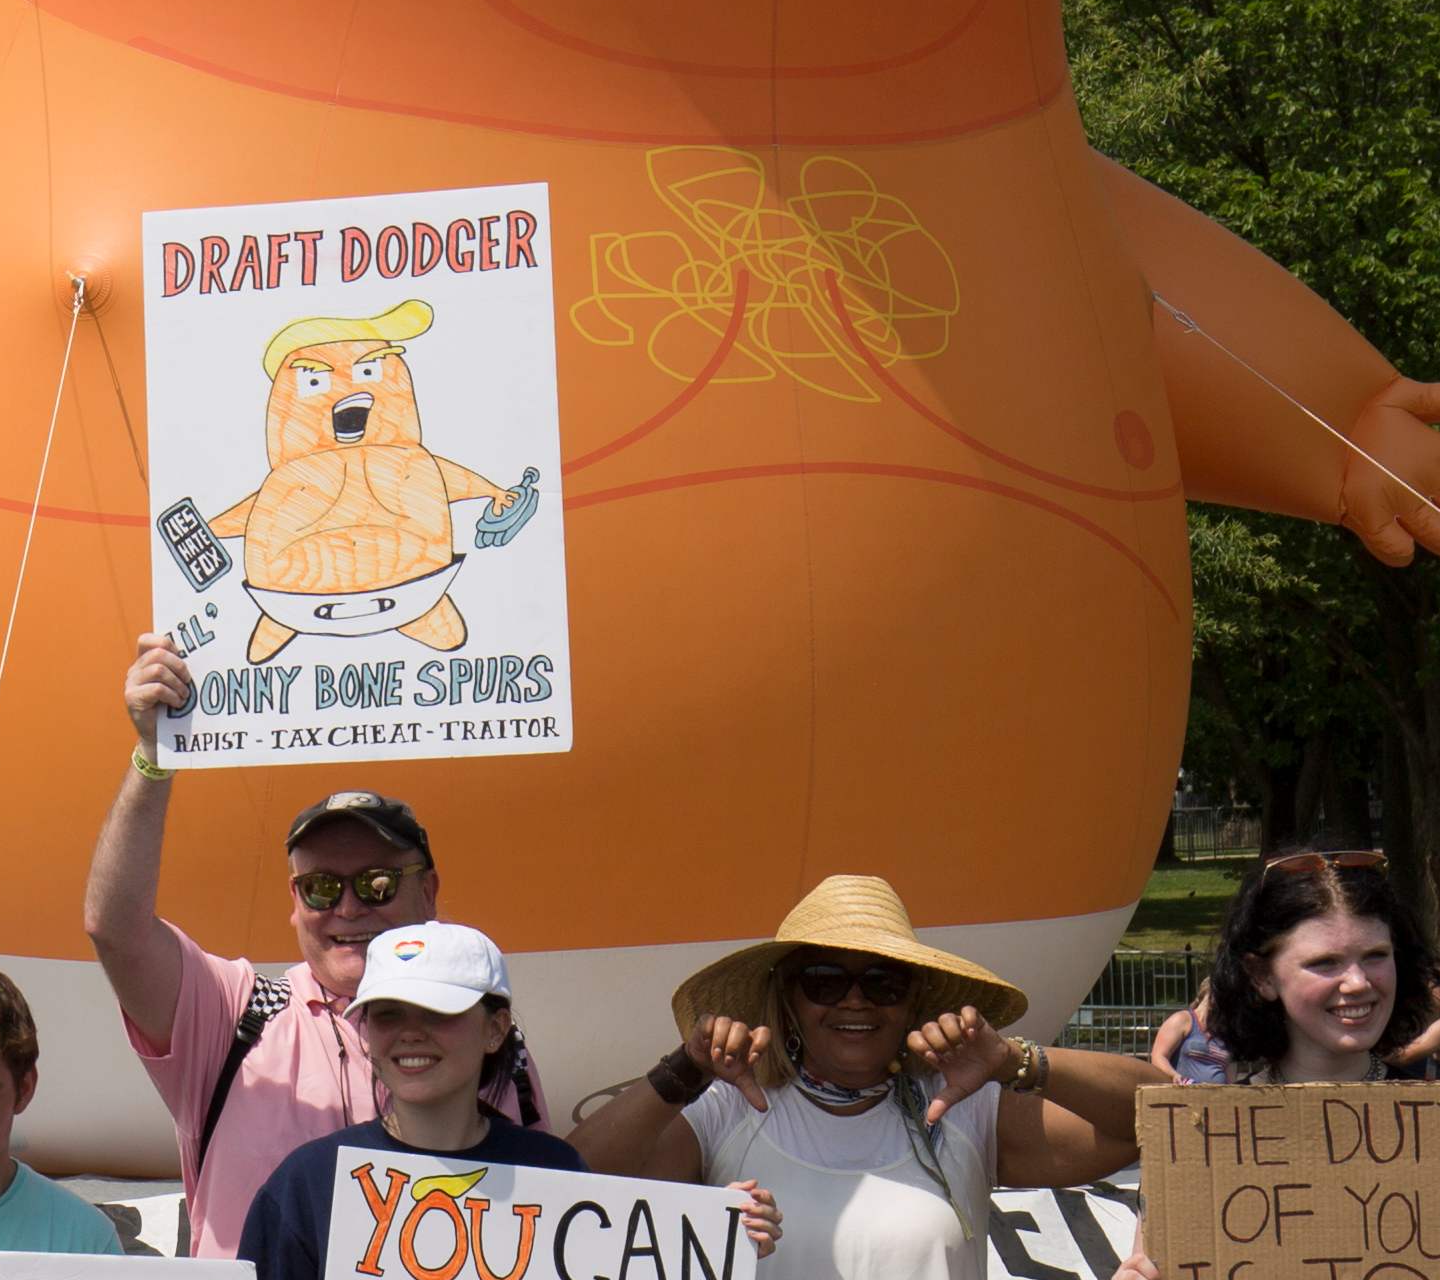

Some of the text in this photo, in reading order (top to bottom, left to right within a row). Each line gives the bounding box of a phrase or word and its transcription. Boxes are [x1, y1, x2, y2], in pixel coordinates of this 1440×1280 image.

[161, 211, 538, 297] DRAFT DODGER
[164, 508, 199, 542] LIES
[177, 529, 212, 562] HATE
[190, 549, 223, 583] FOX
[316, 659, 403, 710] BONE
[413, 655, 554, 707] SPURS
[173, 731, 248, 753] RAPIST
[271, 727, 323, 750] TAX
[327, 721, 421, 746] CHEAT
[440, 716, 560, 743] TRAITOR
[1149, 1102, 1289, 1167] THE
[1221, 1183, 1315, 1246] OF
